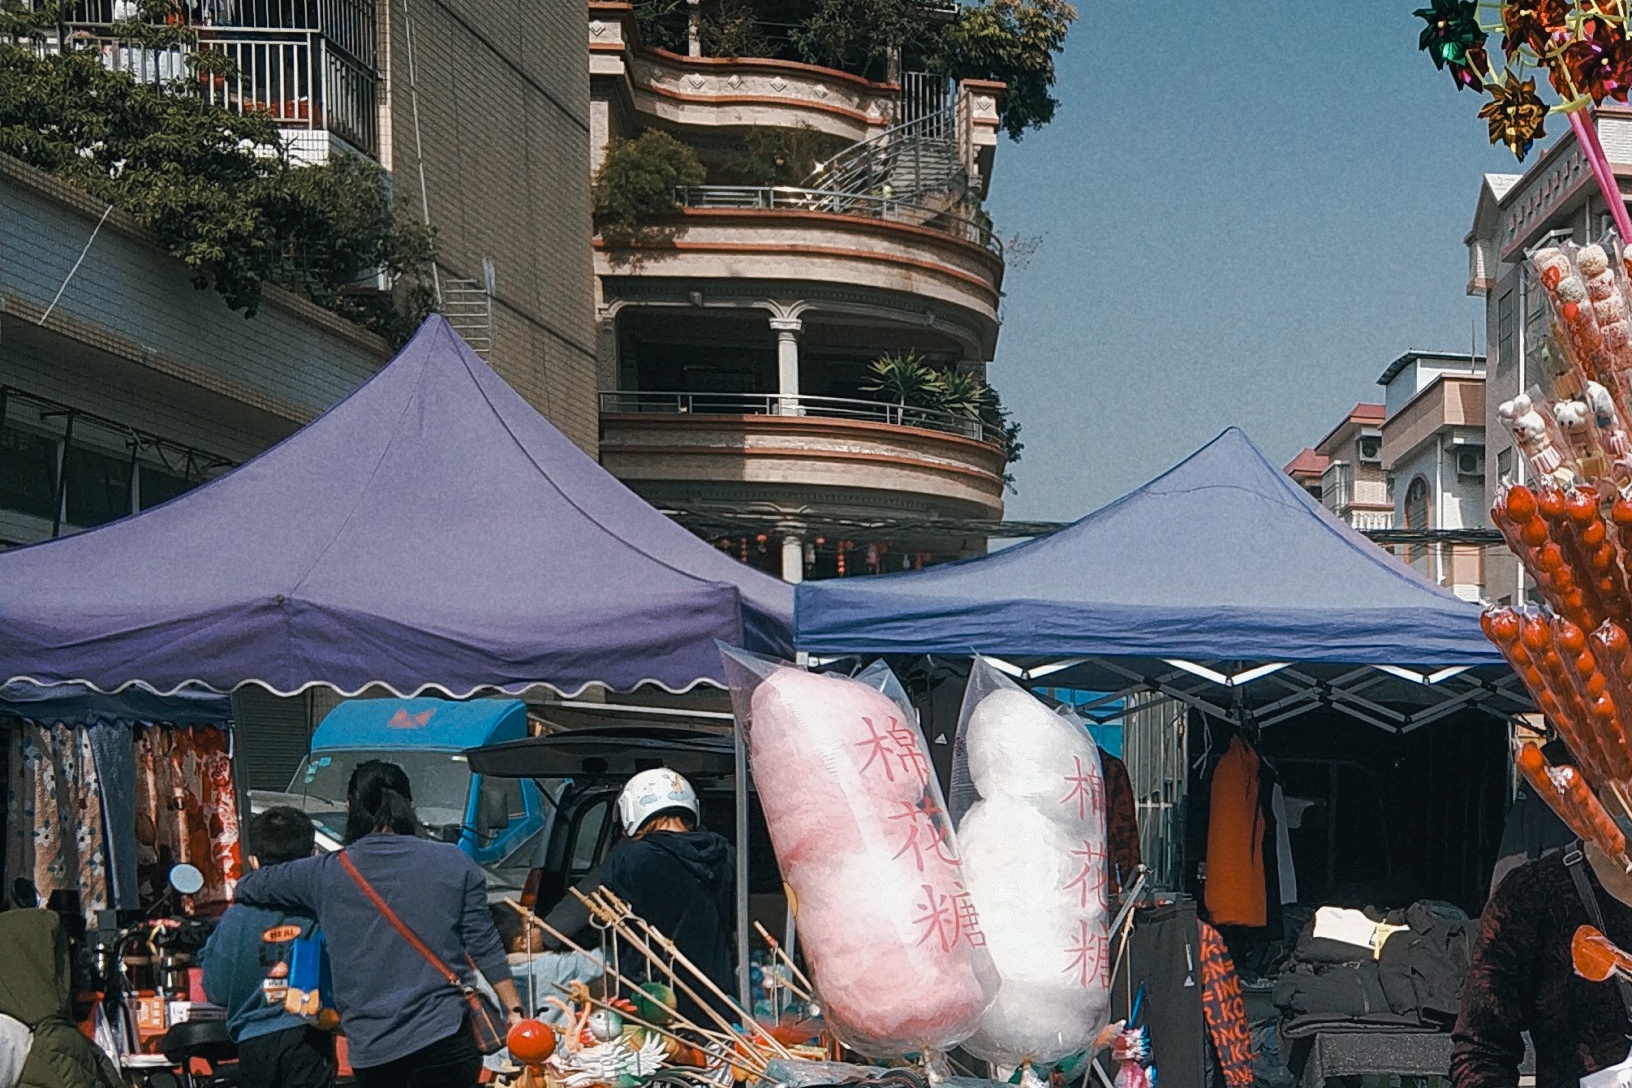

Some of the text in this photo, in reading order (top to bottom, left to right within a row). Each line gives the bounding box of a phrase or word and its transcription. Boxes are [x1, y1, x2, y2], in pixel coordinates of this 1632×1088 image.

[854, 715, 988, 953] 棉花糖
[1058, 754, 1111, 990] 棉花糖
